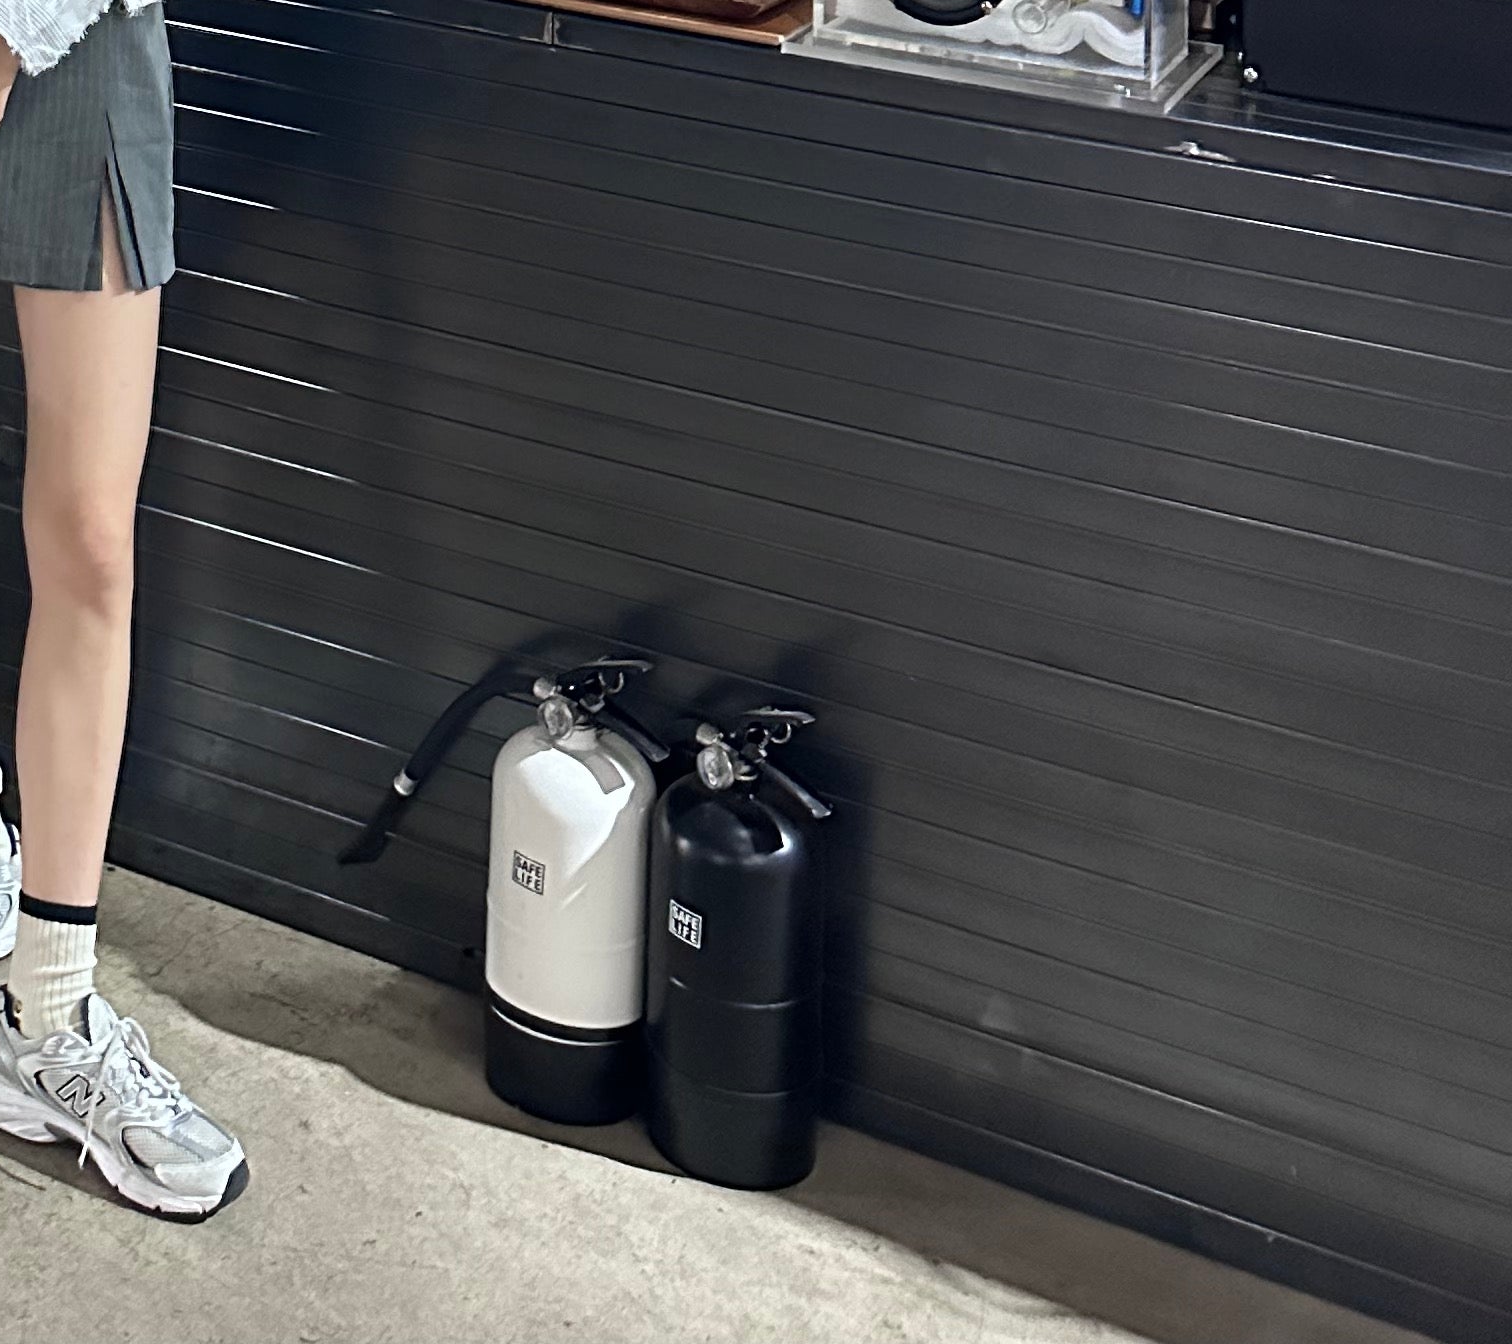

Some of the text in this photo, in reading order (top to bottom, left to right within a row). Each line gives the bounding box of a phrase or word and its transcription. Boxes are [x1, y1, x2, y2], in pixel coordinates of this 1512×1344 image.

[513, 868, 542, 891] LIFE
[514, 855, 542, 879] SAFE
[671, 918, 698, 943] LIFE
[672, 905, 699, 931] SAFE
[56, 1074, 106, 1118] N
